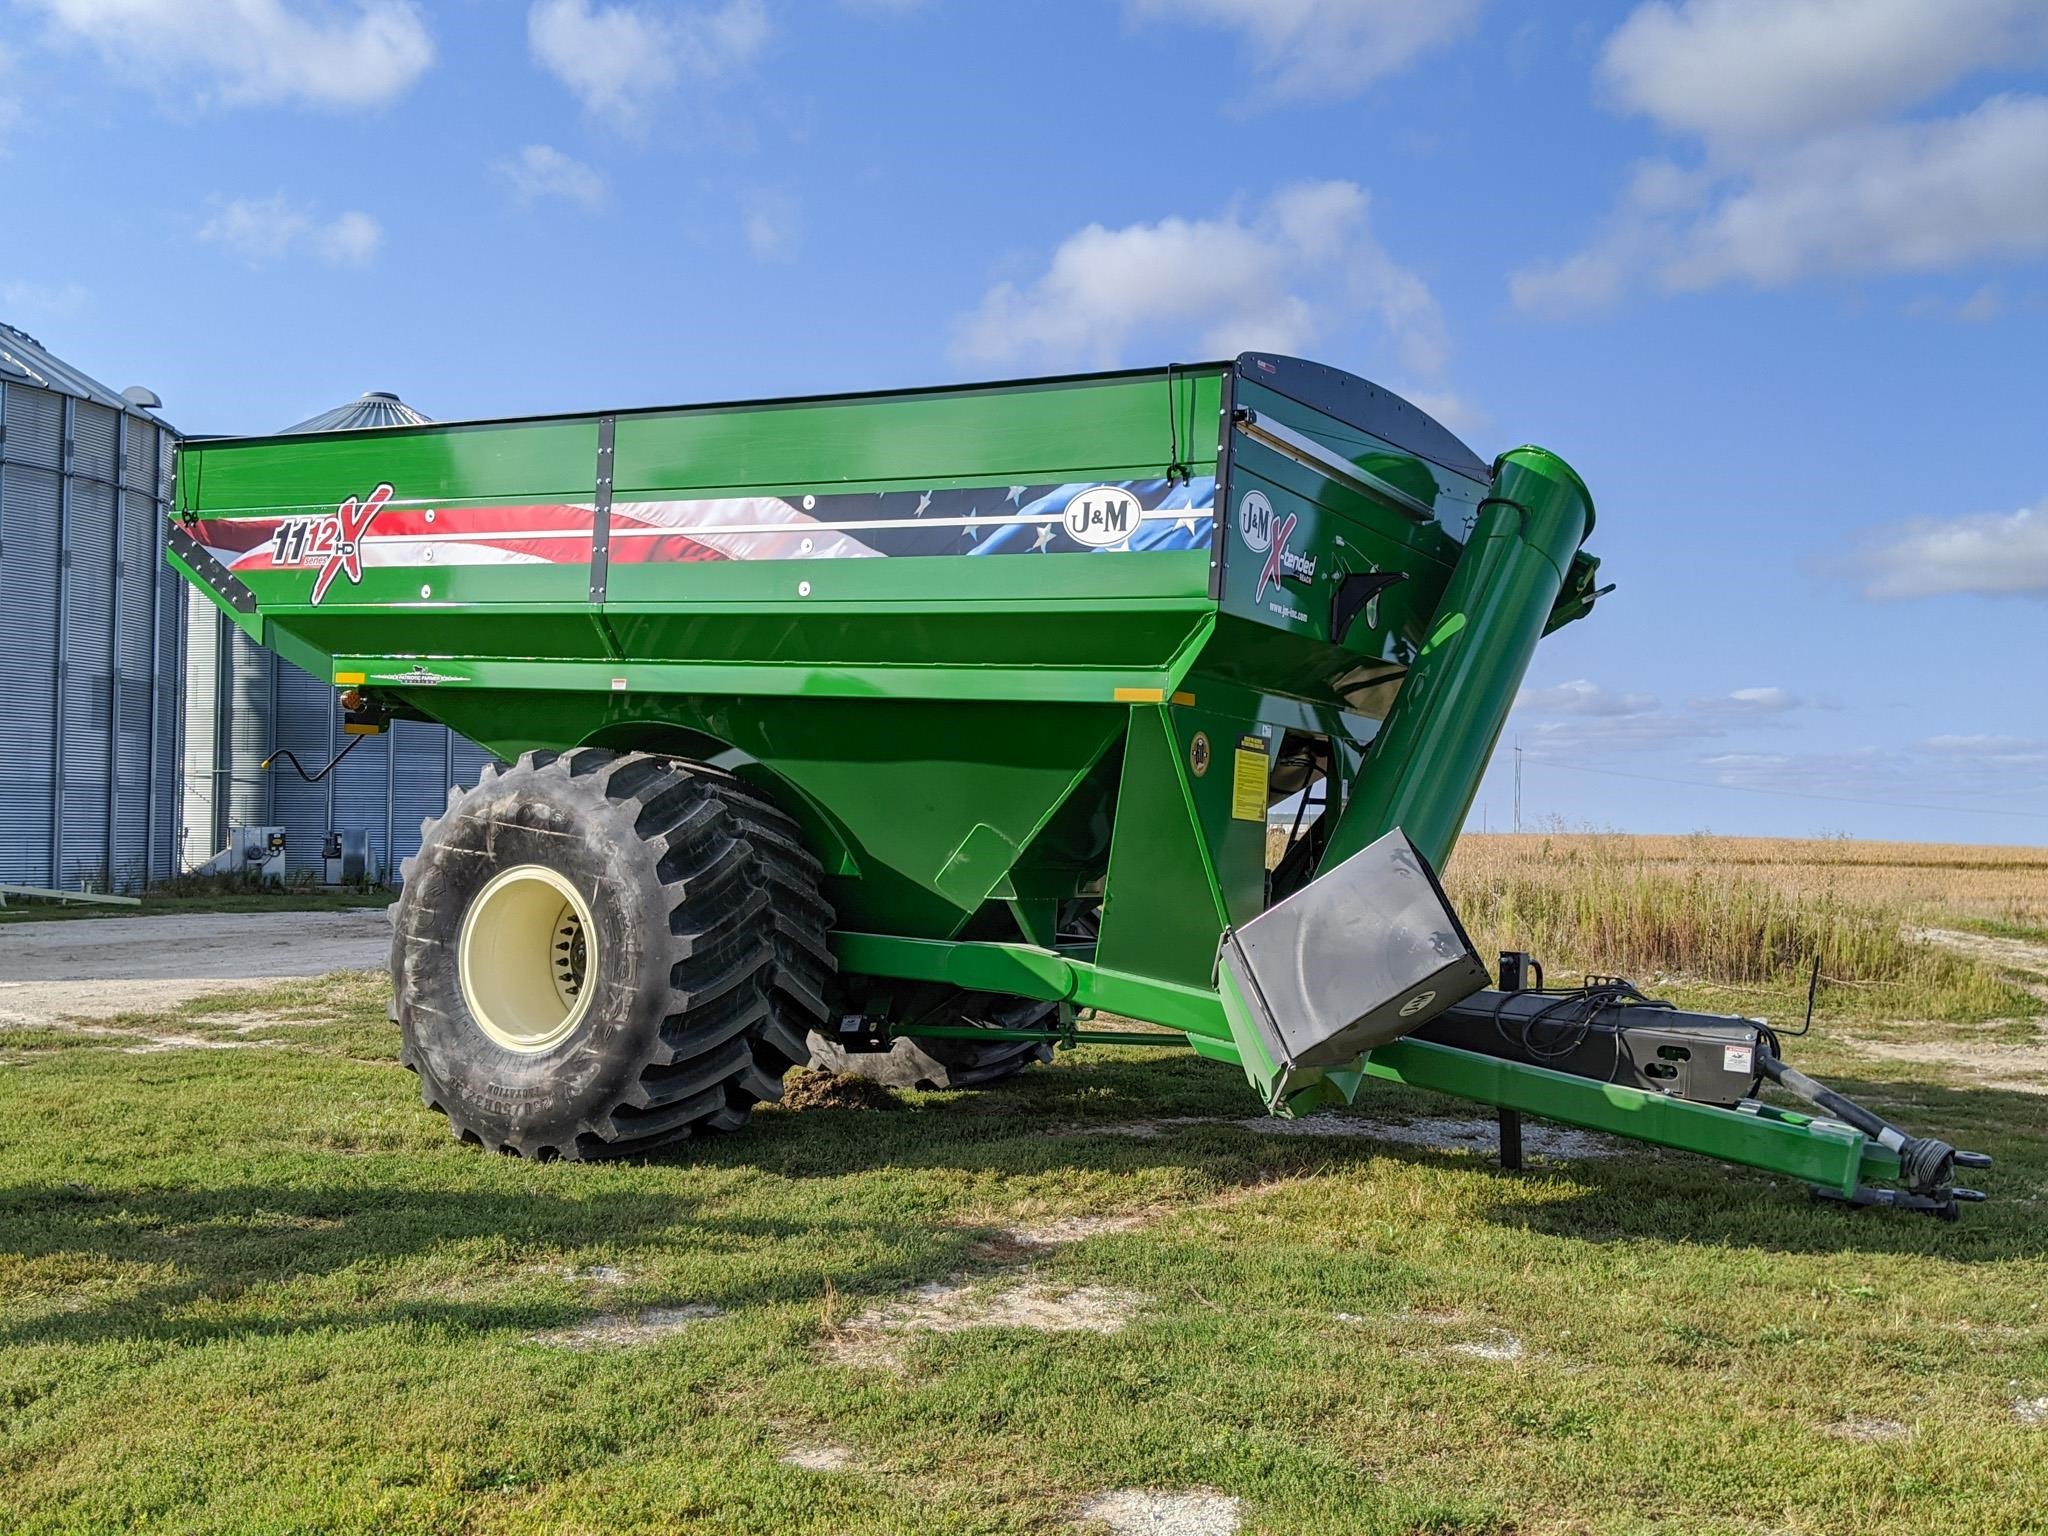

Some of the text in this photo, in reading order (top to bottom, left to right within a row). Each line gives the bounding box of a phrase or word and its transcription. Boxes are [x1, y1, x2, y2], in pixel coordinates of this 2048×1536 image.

[1071, 500, 1129, 533] J&M
[1243, 502, 1269, 541] J&M
[335, 543, 354, 555] HD
[304, 557, 328, 566] series
